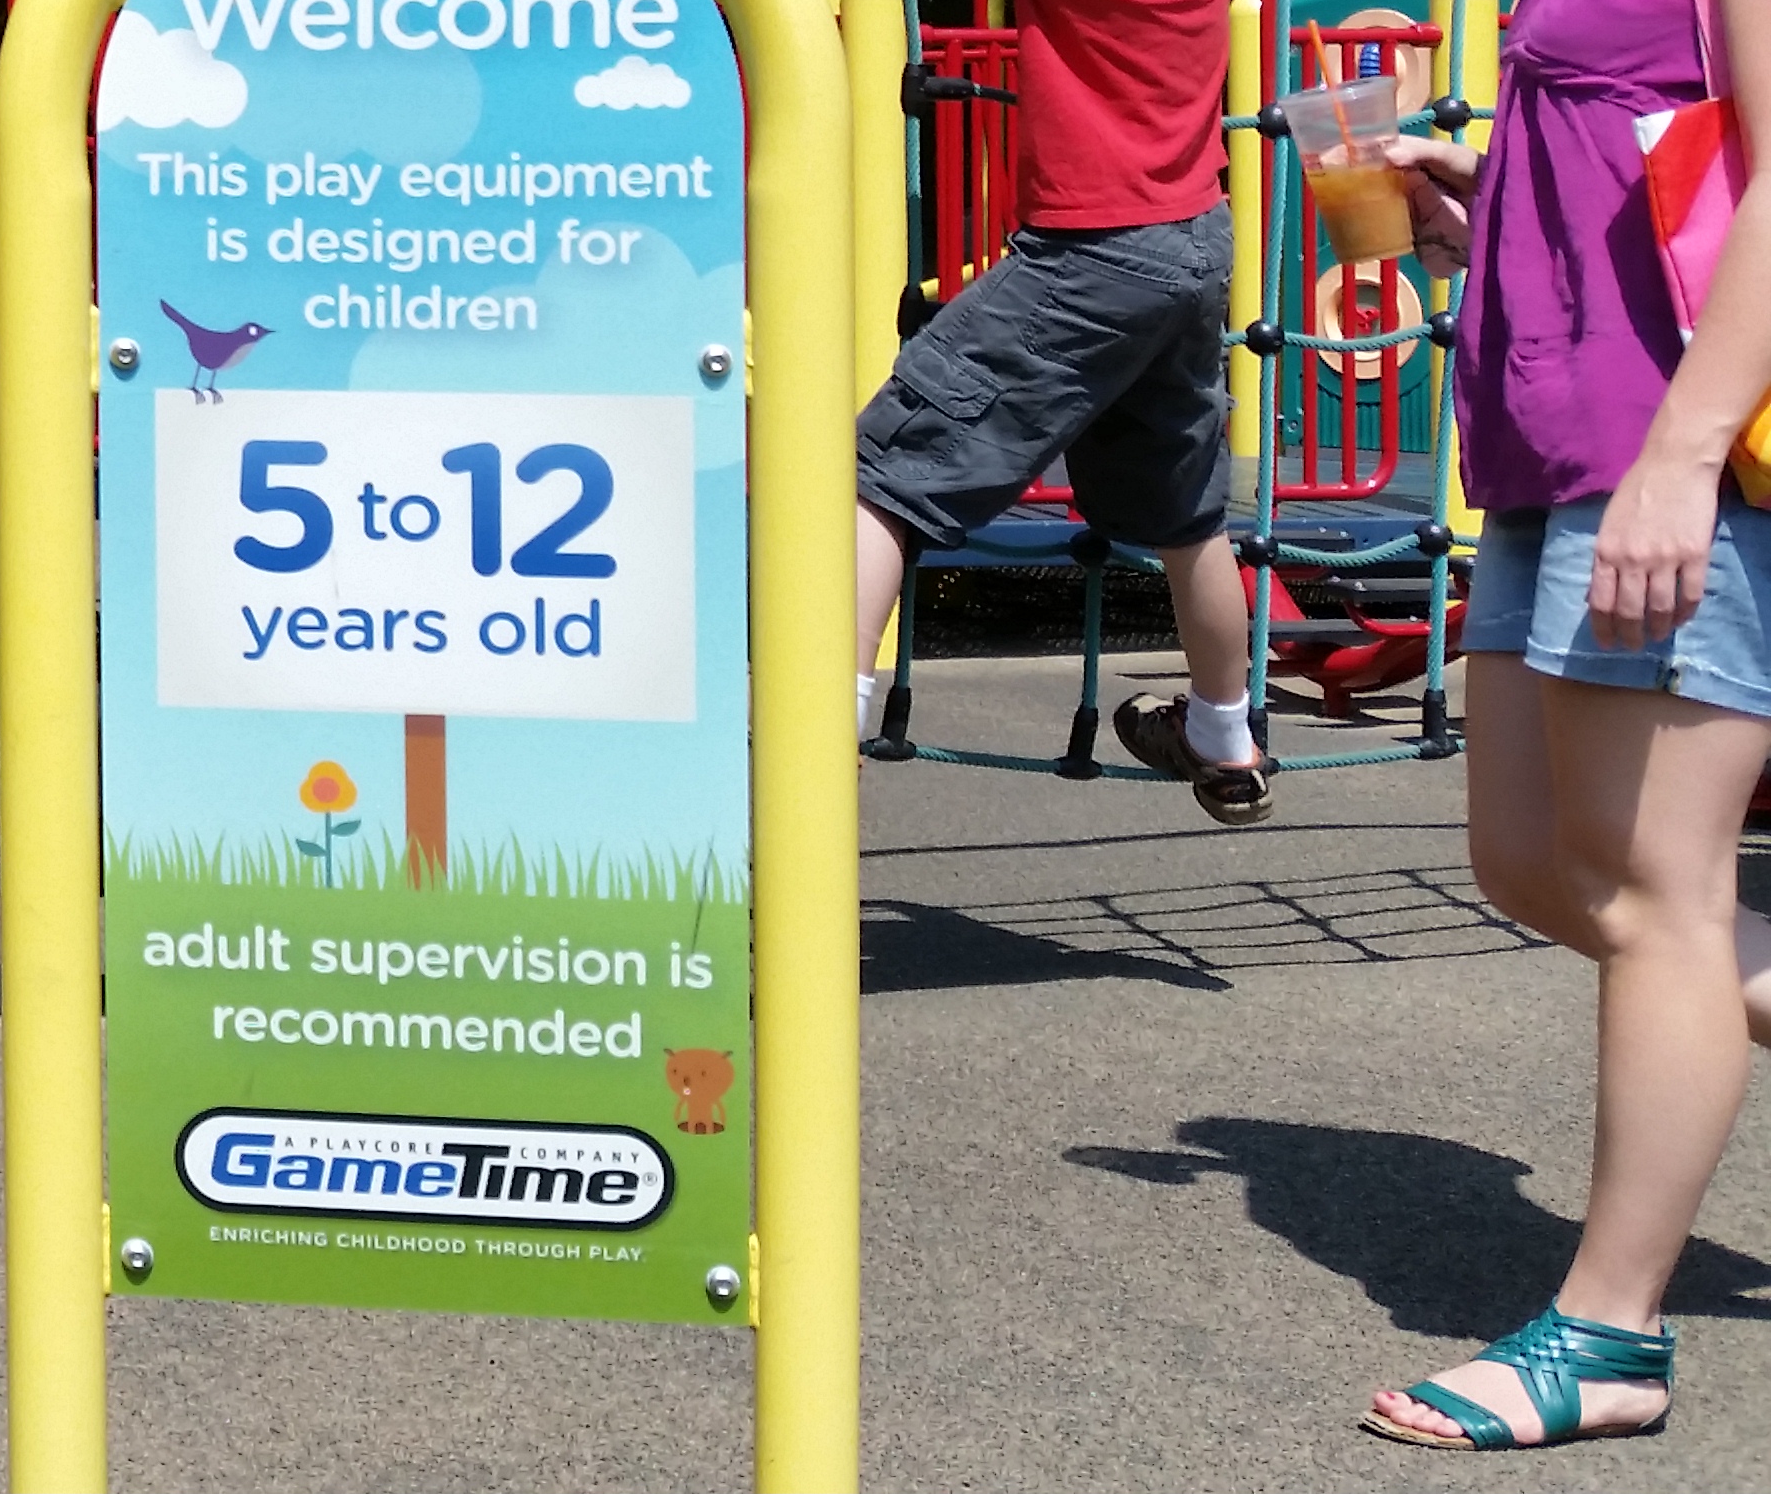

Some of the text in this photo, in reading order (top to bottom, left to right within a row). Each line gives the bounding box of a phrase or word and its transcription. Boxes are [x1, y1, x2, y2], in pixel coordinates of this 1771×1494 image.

[138, 153, 711, 206] This play equipment
[206, 218, 639, 271] is designed for
[303, 284, 538, 330] children
[233, 439, 617, 579] 5 to 12
[242, 597, 601, 659] years old
[143, 924, 713, 988] adult supervision is
[214, 1003, 641, 1058] recommended
[285, 1136, 641, 1164] A PLAYCORE COMPANY
[210, 1226, 328, 1247] ENRICHING
[337, 1234, 466, 1254] CHILDHOOD
[475, 1241, 580, 1259] THROUGH
